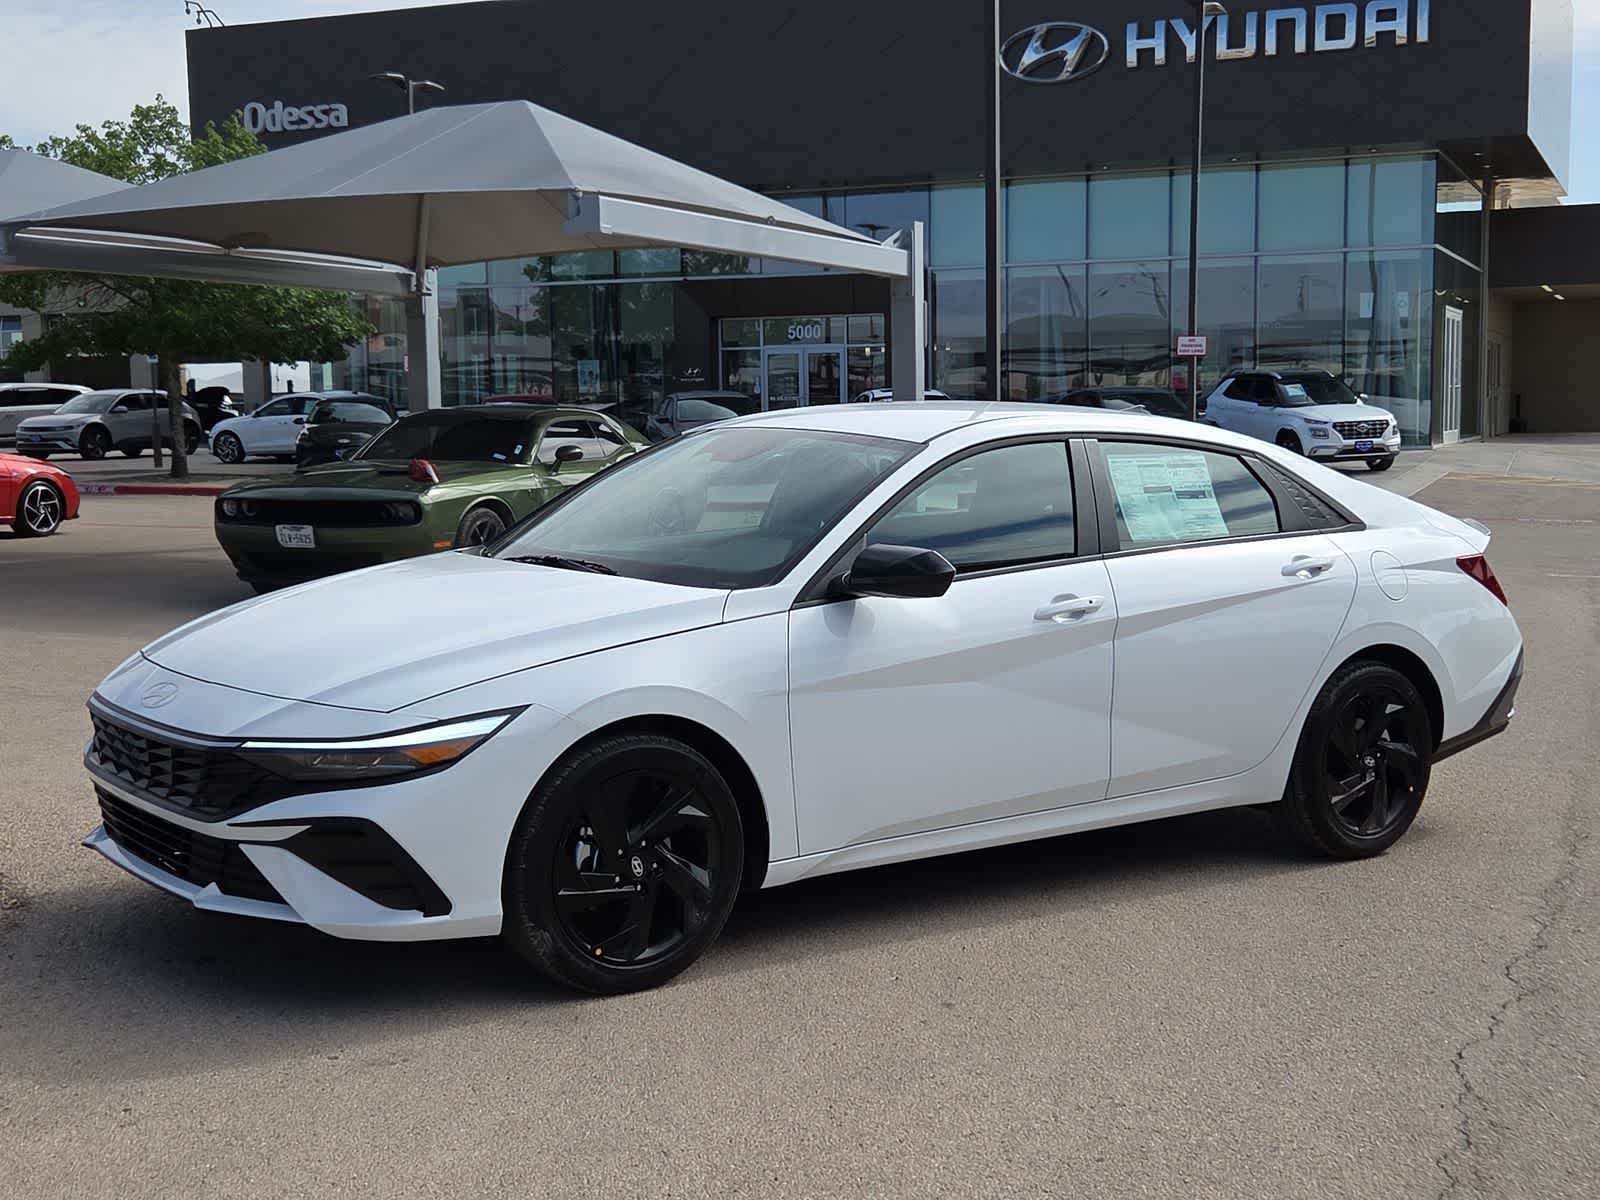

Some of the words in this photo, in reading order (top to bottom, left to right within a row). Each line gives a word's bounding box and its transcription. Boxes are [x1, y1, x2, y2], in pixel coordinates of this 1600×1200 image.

[1126, 0, 1429, 68] HYUNDAI
[243, 100, 349, 133] Odessa
[787, 325, 821, 340] 5000
